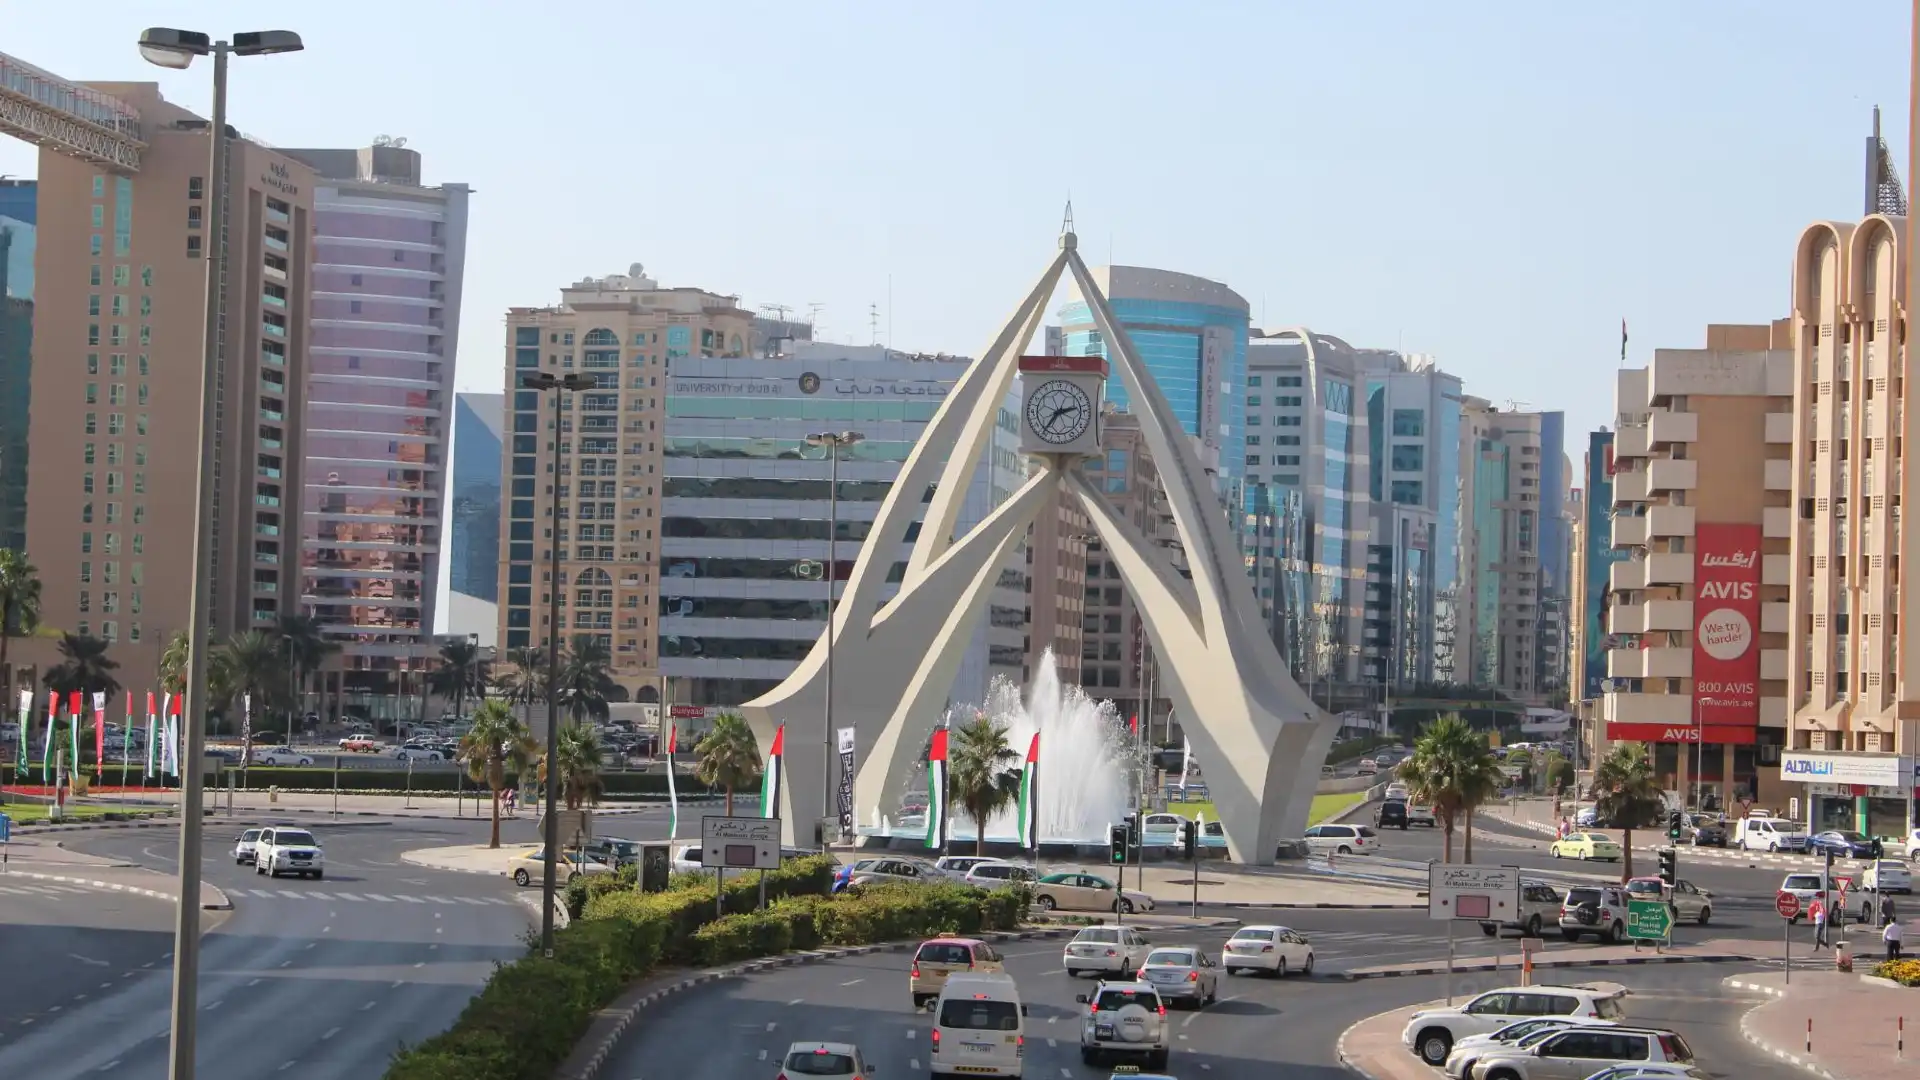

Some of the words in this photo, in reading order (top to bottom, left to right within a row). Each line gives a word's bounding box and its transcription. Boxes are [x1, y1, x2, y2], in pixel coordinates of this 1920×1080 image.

[676, 383, 732, 394] UNIVERSITY
[1700, 580, 1753, 600] AVIS
[1704, 623, 1725, 634] We
[1725, 622, 1741, 632] try
[1707, 633, 1743, 645] harder
[1698, 682, 1721, 693] 800
[1724, 682, 1754, 694] AVIS
[1698, 697, 1754, 708] www.avis.ae
[1663, 728, 1700, 740] AVIS
[1780, 905, 1797, 913] STOP
